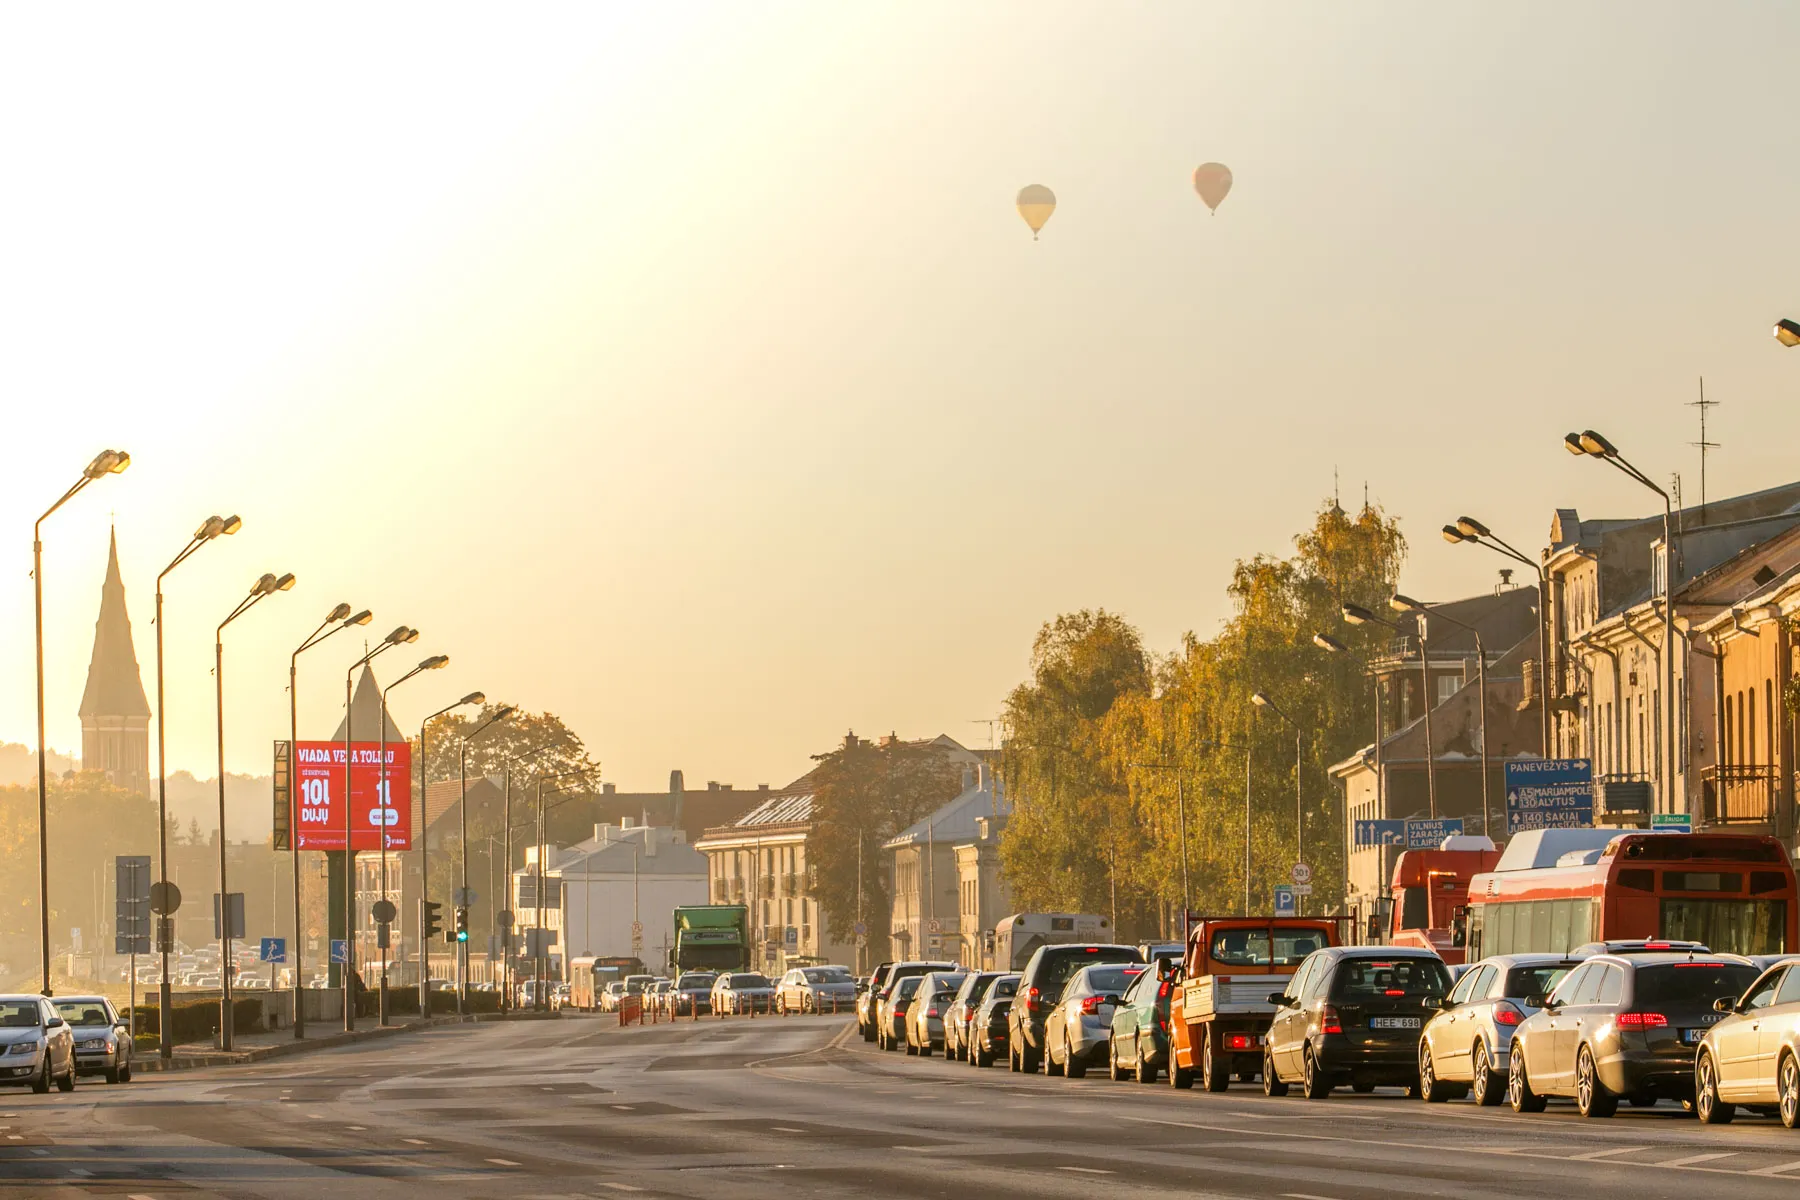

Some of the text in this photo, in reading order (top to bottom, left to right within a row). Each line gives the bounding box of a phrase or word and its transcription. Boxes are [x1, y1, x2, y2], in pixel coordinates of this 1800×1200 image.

[298, 749, 331, 763] VIADA
[333, 749, 358, 763] VEA
[1510, 760, 1570, 772] PANEVĖŽYS
[1520, 788, 1534, 798] A5
[1520, 797, 1576, 808] 130 ALYTUS
[301, 807, 329, 825] DUJŲ
[1524, 810, 1579, 822] 140 ŠAKIAI
[1409, 821, 1443, 830] VILNIUS
[1510, 822, 1563, 834] JURBARKAS
[1410, 829, 1447, 839] ZARASAI
[1410, 838, 1444, 847] KLAIPĖD
[1280, 892, 1291, 909] P
[1375, 1018, 1419, 1028] HEE 698
